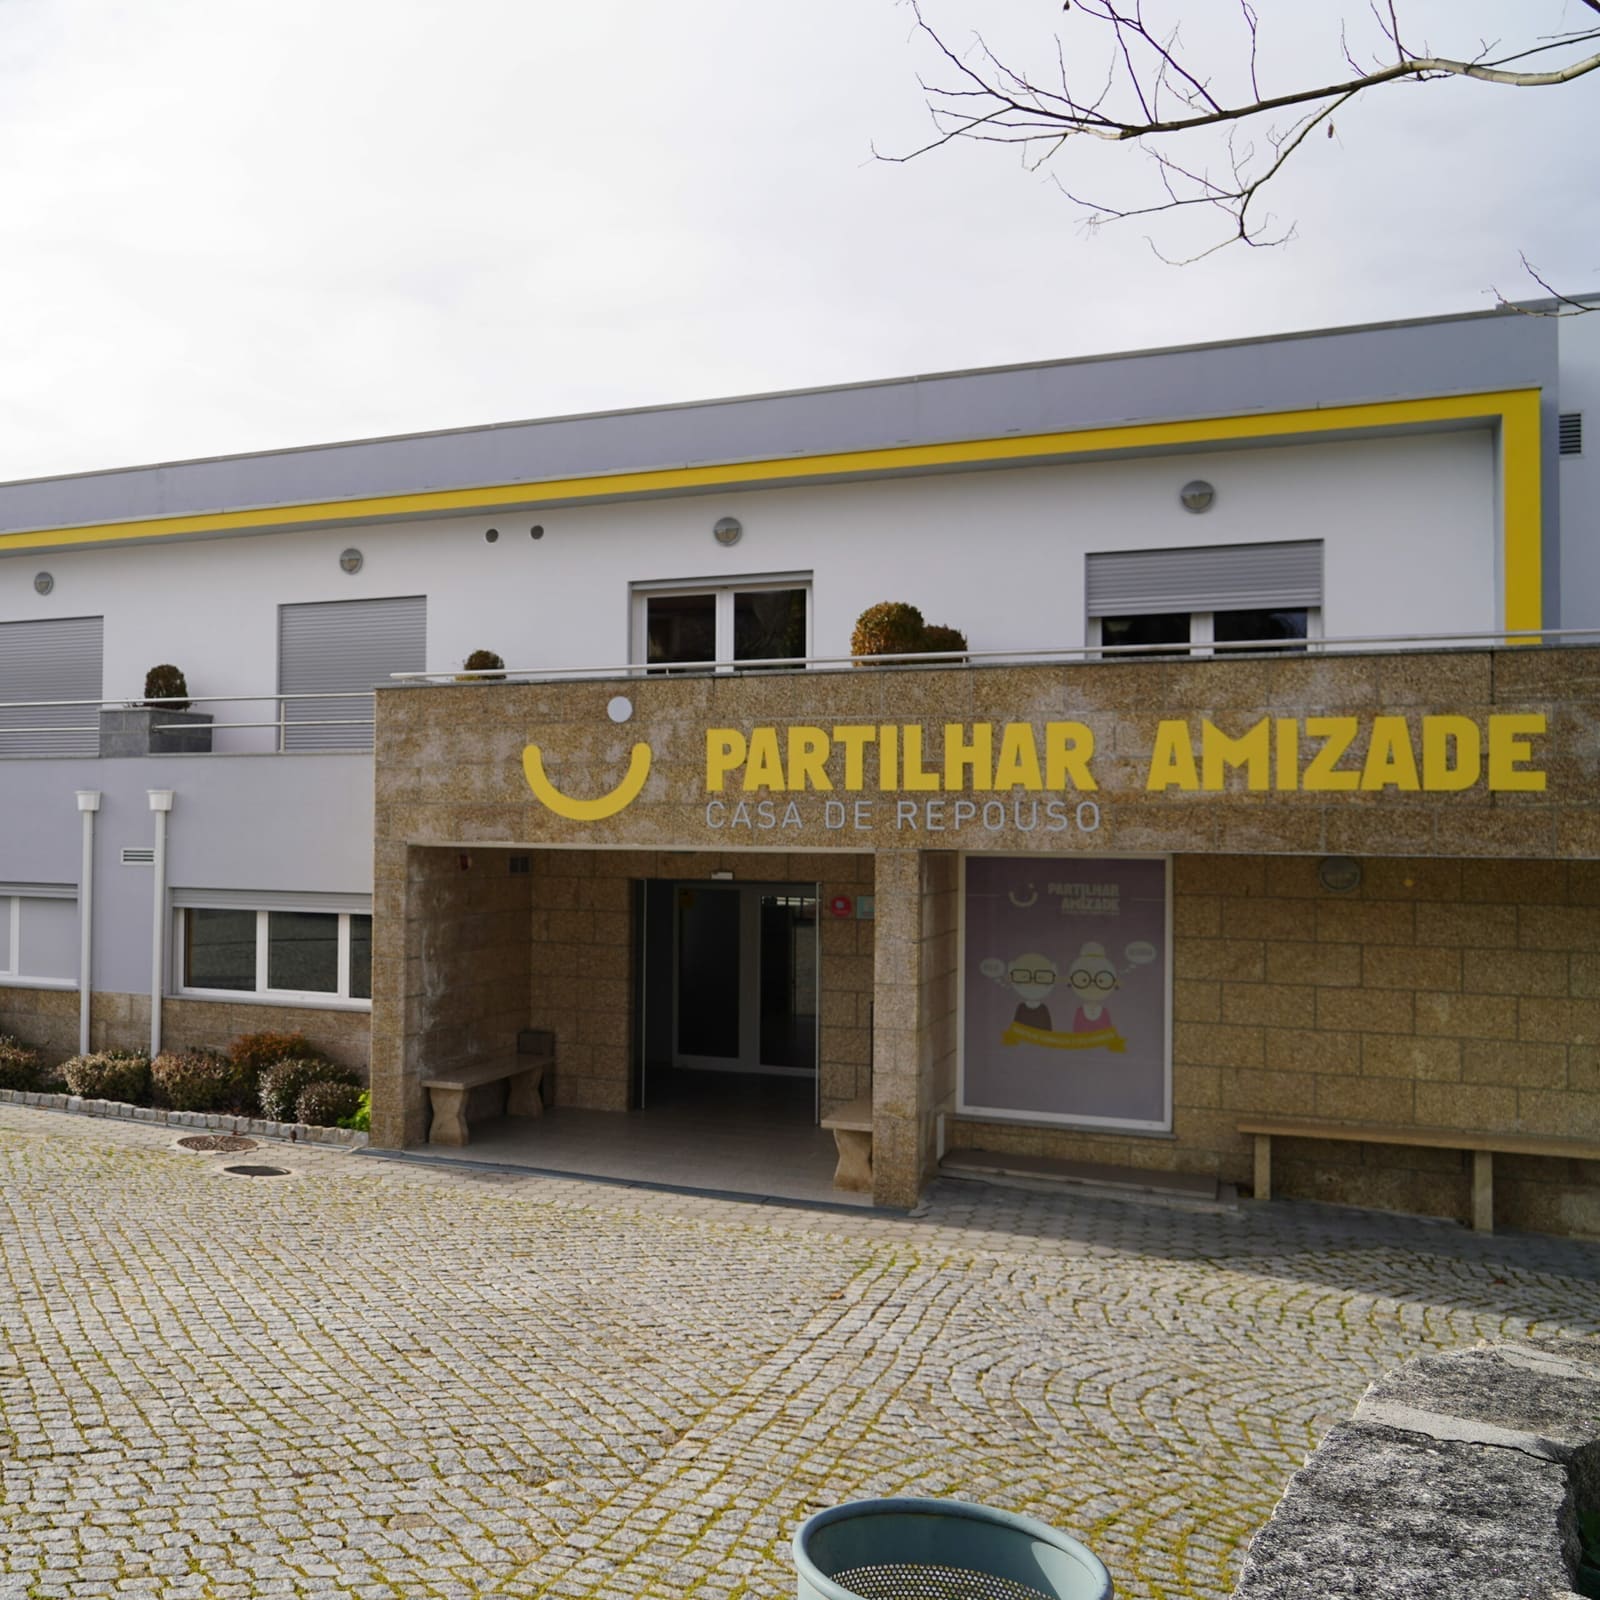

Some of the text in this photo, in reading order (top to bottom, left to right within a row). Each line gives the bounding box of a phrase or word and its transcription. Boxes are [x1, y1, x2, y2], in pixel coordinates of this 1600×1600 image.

[706, 713, 1547, 792] PARTILHAR AMIZADE
[706, 800, 1102, 833] CASA DE REPOUSO
[1047, 882, 1120, 897] PARTILHAR
